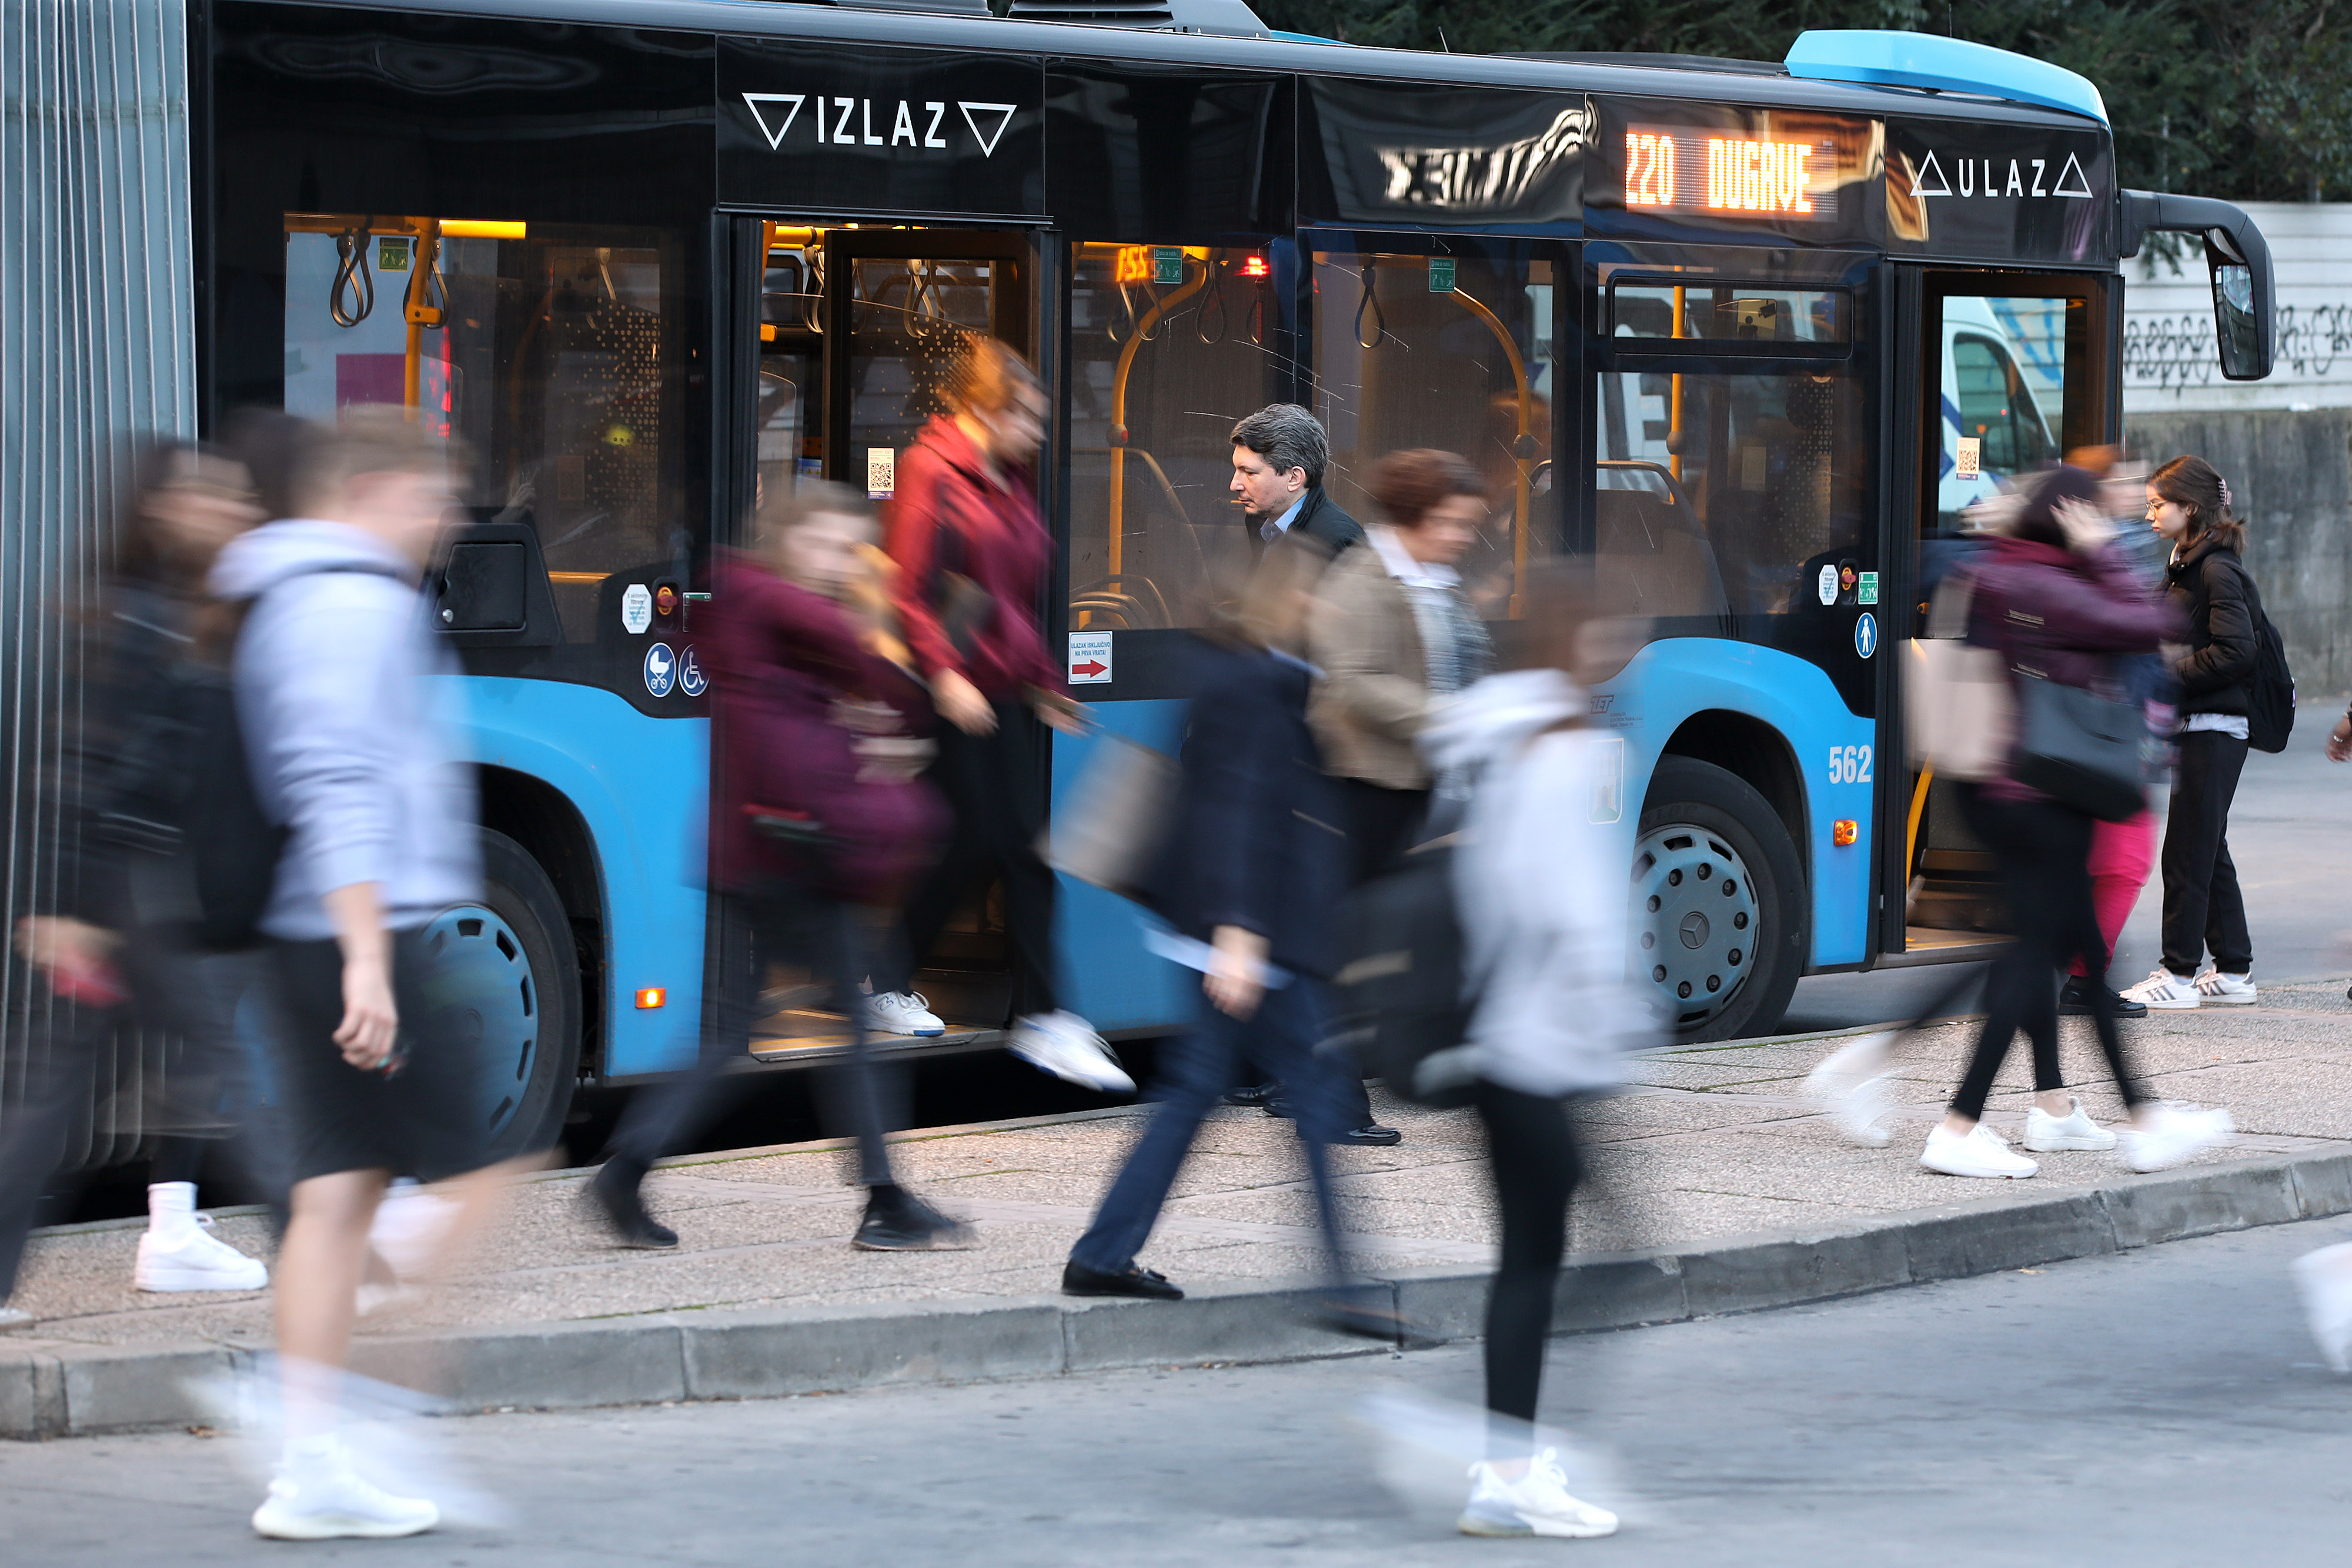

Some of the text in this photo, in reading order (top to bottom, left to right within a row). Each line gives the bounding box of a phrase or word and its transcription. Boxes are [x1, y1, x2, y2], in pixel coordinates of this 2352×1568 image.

[817, 96, 946, 148] IZLAZ
[1625, 133, 1812, 213] 220 DUGAVE
[1958, 159, 2046, 198] ULAZ
[1829, 744, 1872, 784] 562
